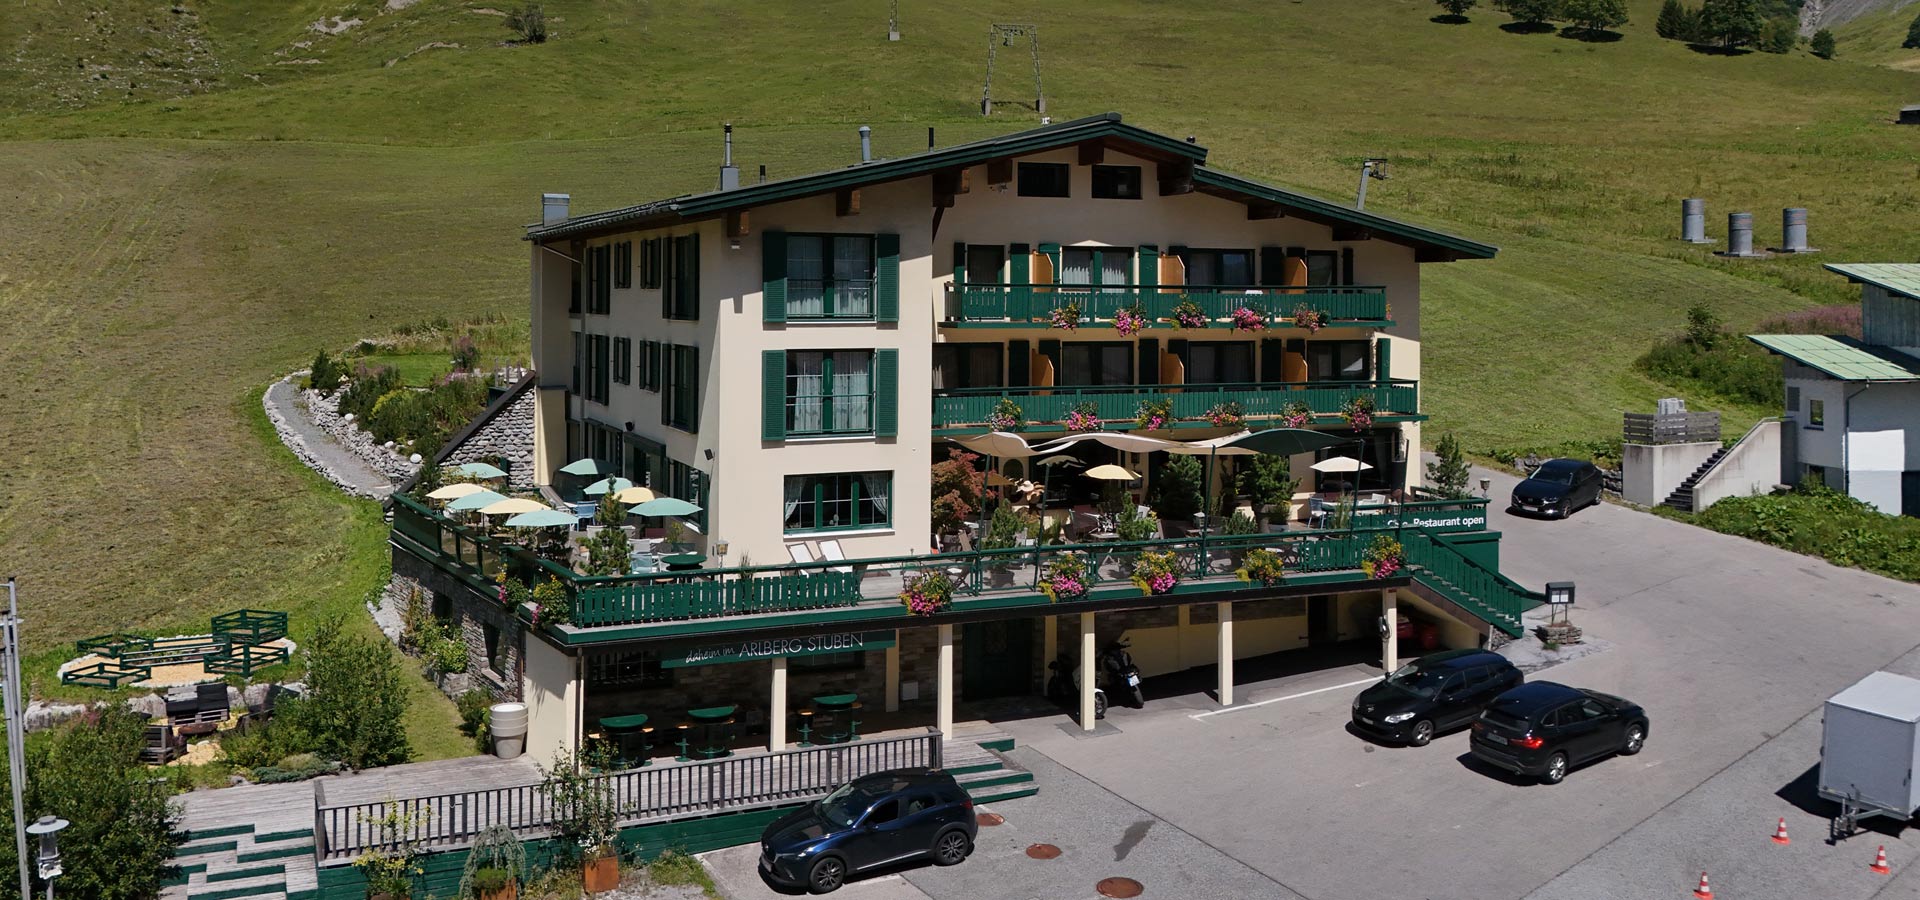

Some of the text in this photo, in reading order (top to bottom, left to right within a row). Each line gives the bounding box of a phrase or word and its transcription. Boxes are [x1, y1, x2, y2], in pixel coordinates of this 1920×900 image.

[1462, 517, 1484, 528] open
[739, 638, 802, 657] ARLBERG
[807, 633, 863, 652] STUBEN
